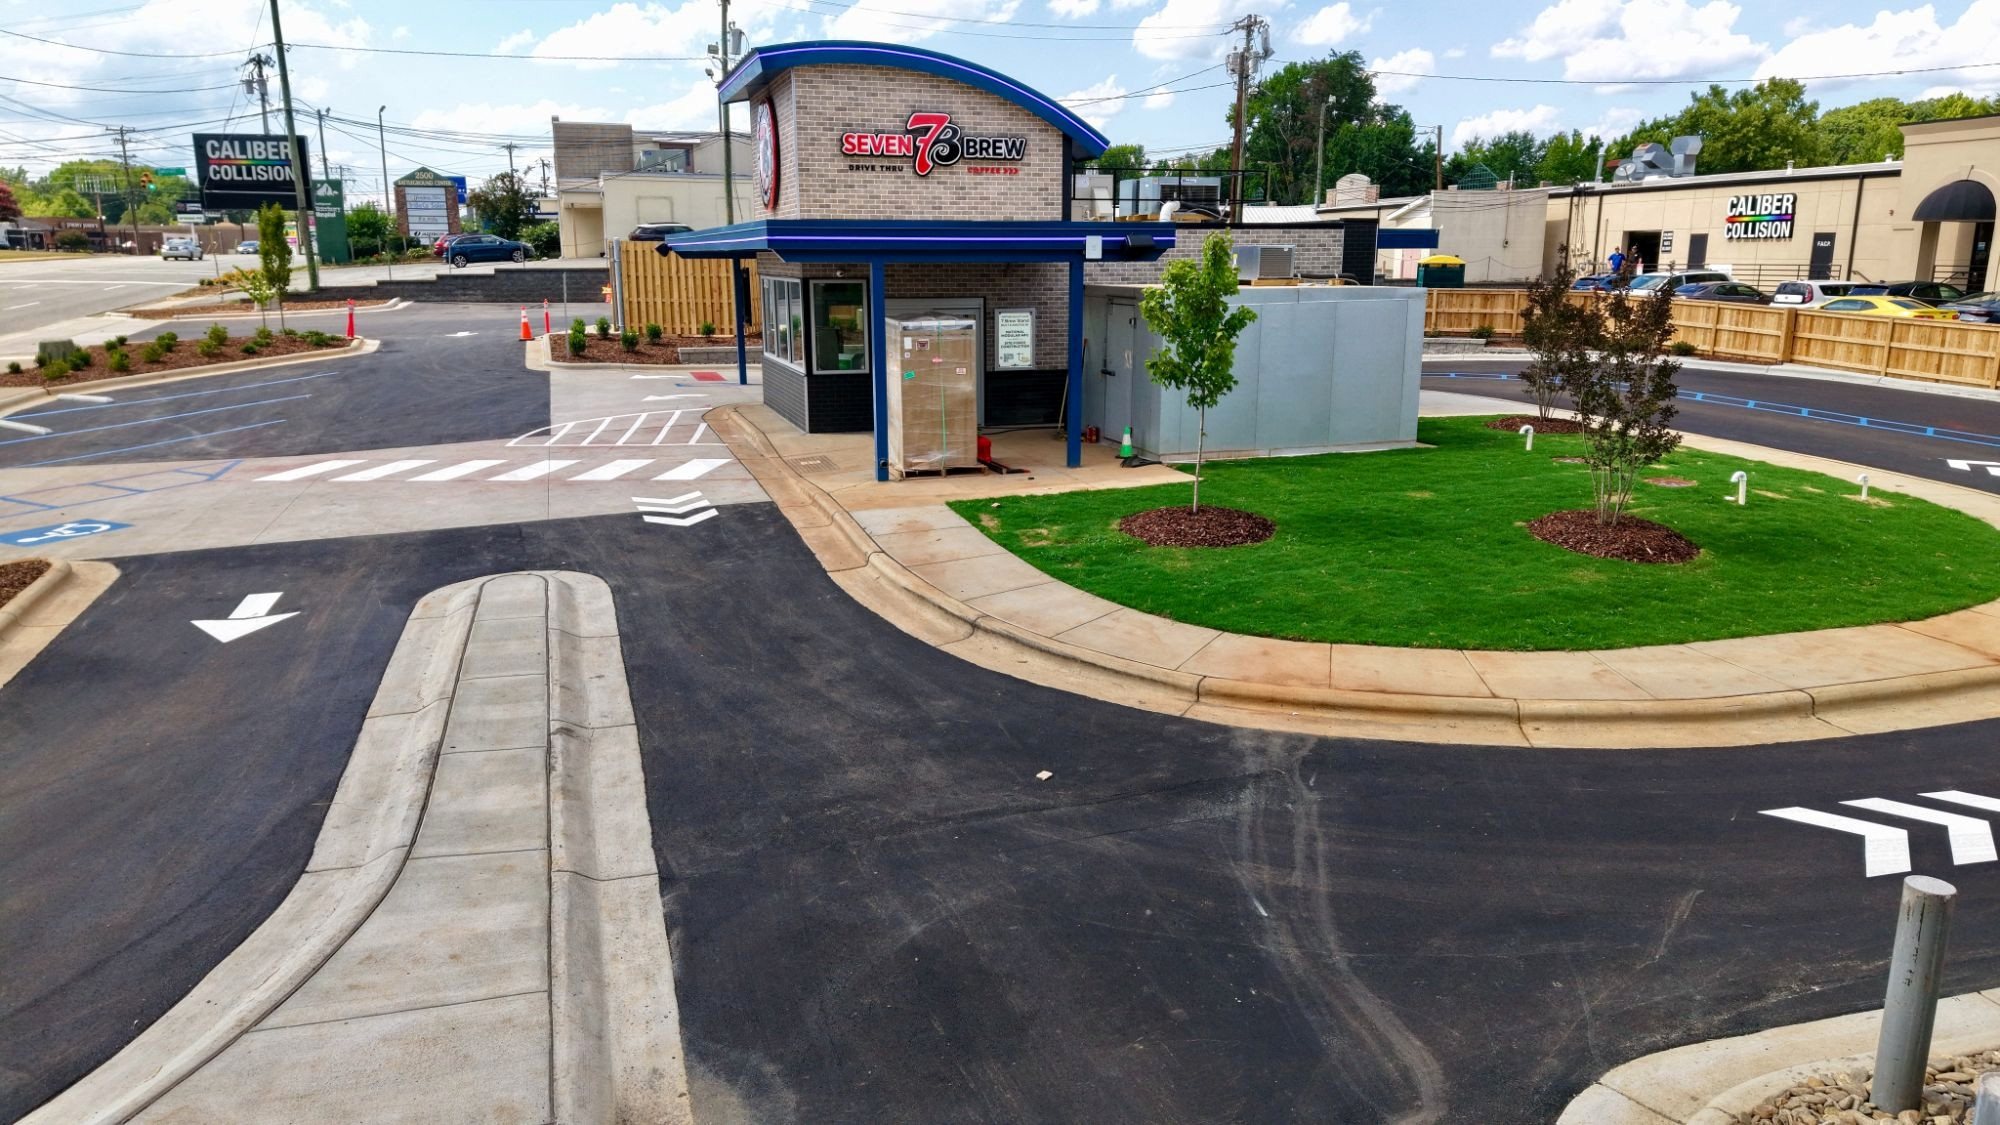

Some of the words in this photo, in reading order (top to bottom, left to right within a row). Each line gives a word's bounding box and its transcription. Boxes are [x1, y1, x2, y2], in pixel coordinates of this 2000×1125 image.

[206, 139, 291, 160] CALIBER
[842, 133, 913, 156] SEVEN
[964, 137, 1026, 159] BREW
[208, 164, 295, 181] COLLISION
[415, 171, 434, 179] 2500
[848, 164, 876, 172] DRIVE
[967, 166, 1001, 174] COFFEE
[1727, 194, 1794, 216] CALIBER
[1724, 221, 1792, 239] COLLISION
